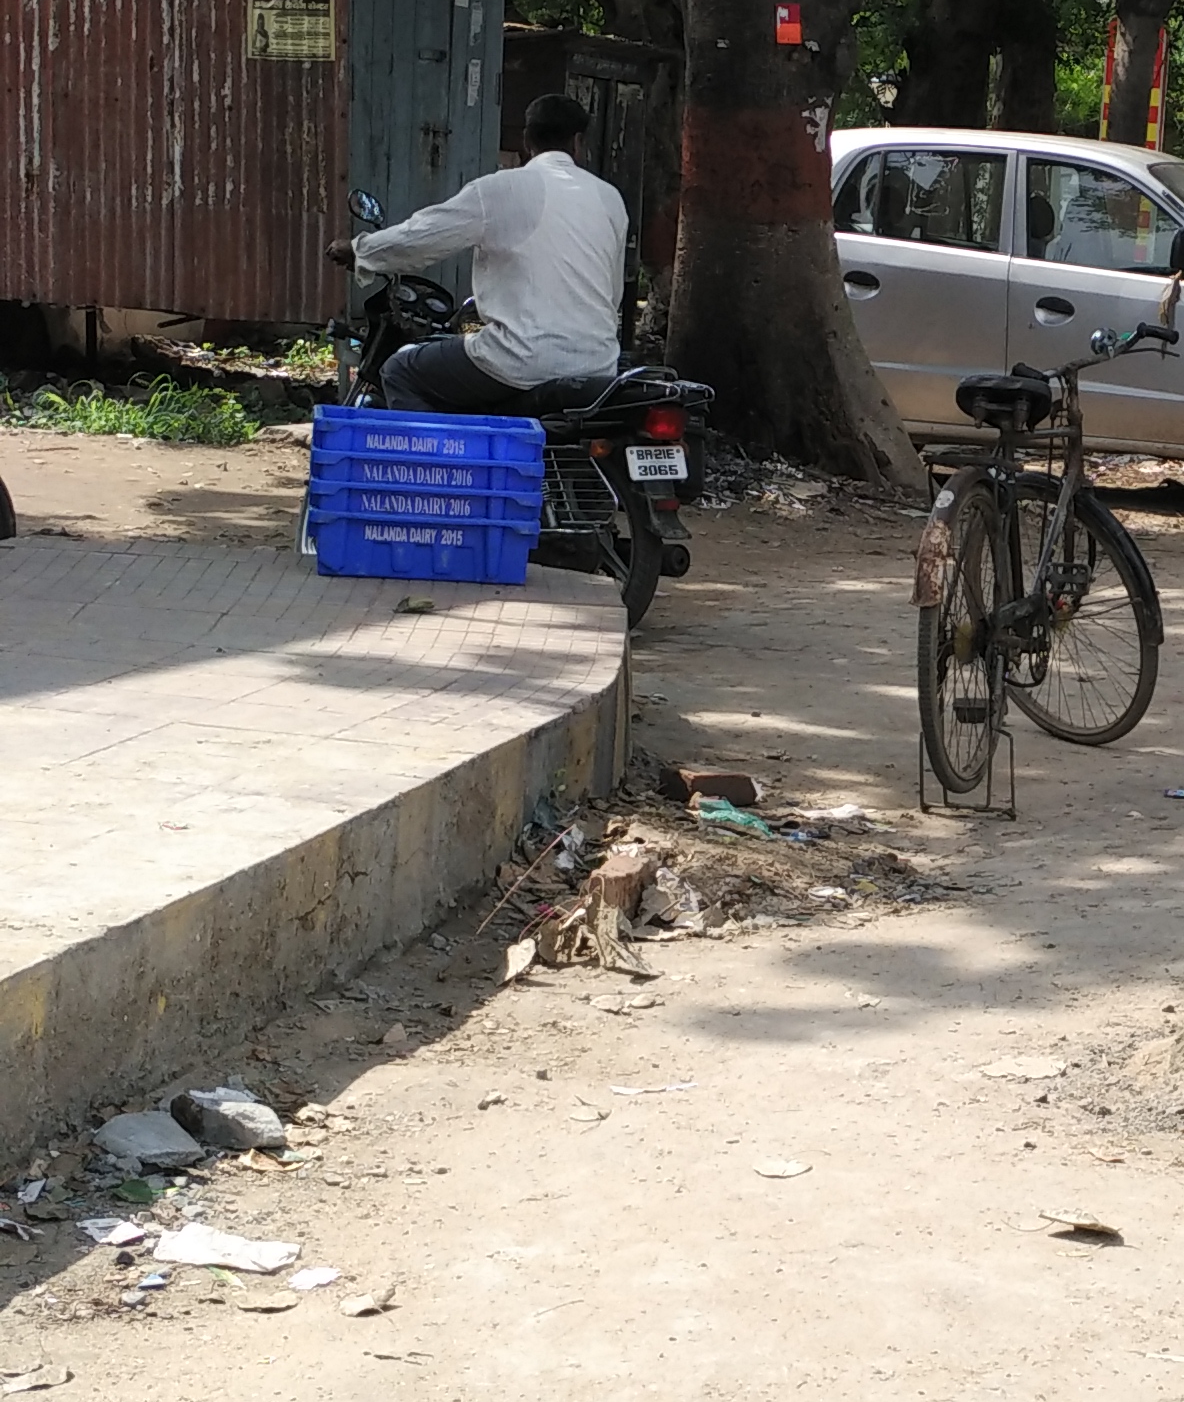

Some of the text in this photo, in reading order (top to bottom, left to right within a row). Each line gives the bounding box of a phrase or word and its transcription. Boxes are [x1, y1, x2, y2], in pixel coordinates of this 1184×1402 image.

[366, 433, 465, 455] NALANDA DAIRY 2015
[363, 463, 473, 487] NALANDA DAIRY 2016
[638, 465, 679, 476] 3065
[361, 493, 471, 517] NALANDA DAIRY 2016
[364, 524, 463, 546] NALANDA DAIRY 2015
